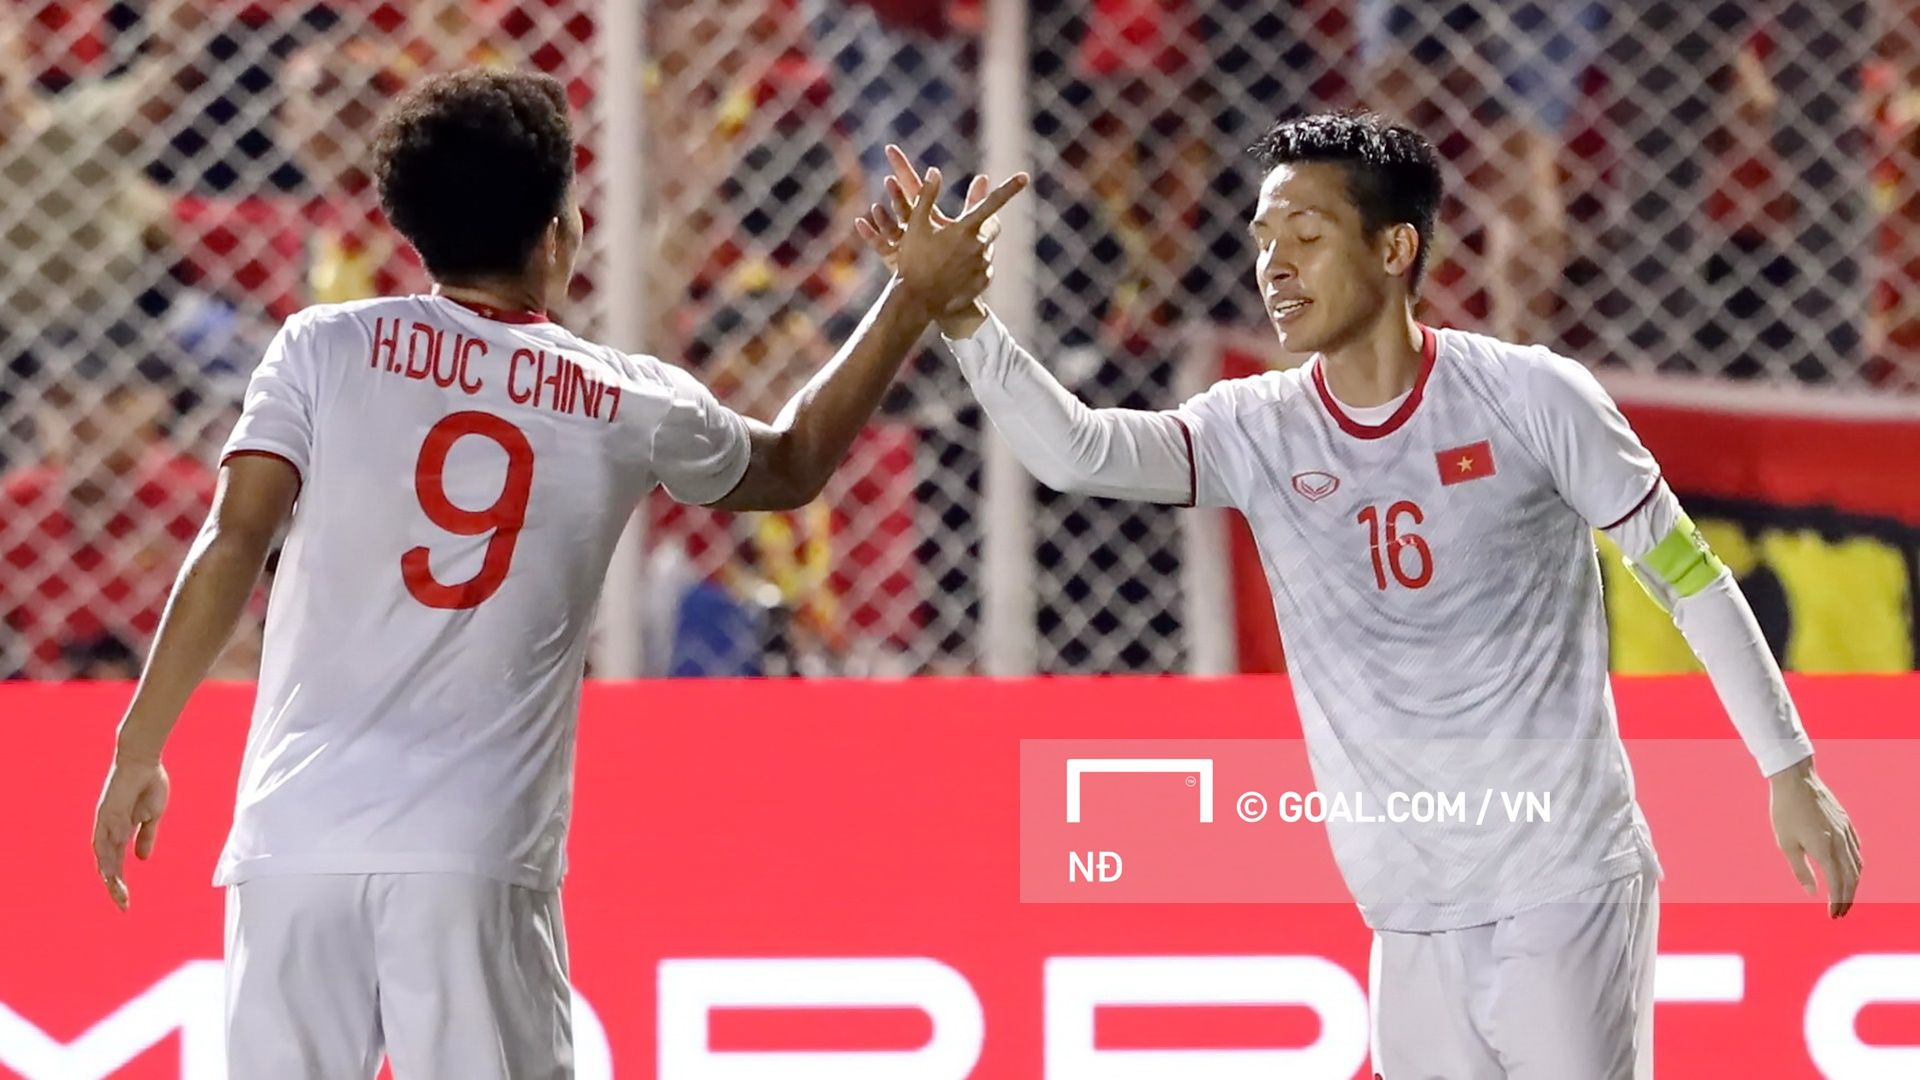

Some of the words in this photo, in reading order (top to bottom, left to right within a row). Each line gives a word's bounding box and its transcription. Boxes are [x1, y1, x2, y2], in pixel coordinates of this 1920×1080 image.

[371, 317, 488, 395] H.DUC
[507, 347, 622, 423] CHINH
[401, 410, 535, 610] 9
[1357, 500, 1434, 591] 16
